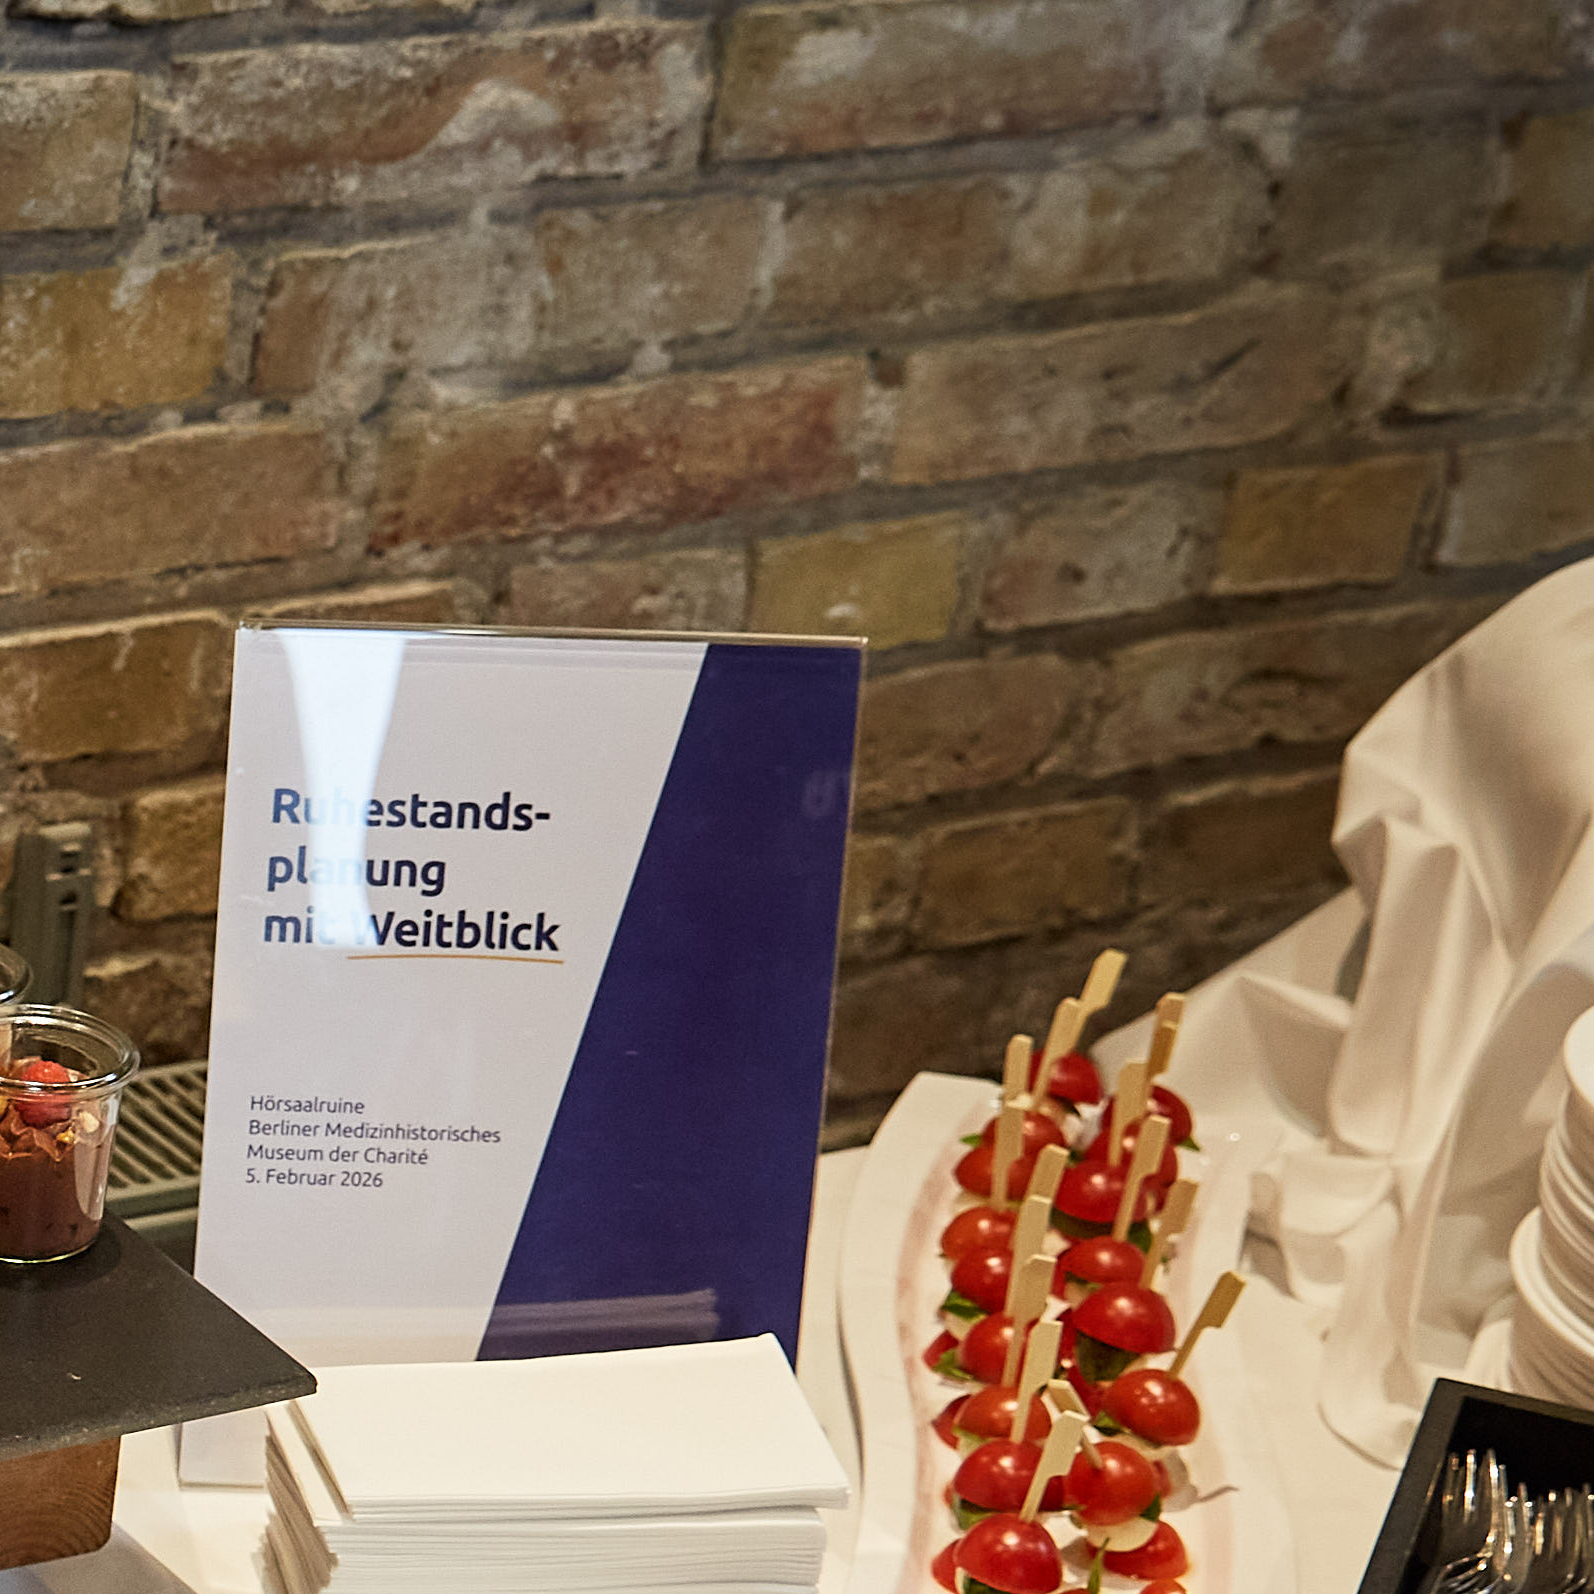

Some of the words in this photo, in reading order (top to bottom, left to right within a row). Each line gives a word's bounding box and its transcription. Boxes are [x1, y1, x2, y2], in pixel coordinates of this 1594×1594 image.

[249, 1095, 365, 1115] Hörsaalruine
[248, 1119, 321, 1138] Berliner
[324, 1122, 502, 1144] Medizinhistorisches
[246, 1144, 324, 1162] Museum
[329, 1145, 359, 1163] der
[363, 1147, 429, 1165] Charité
[245, 1168, 261, 1185] 5.
[265, 1168, 336, 1186] Februar
[340, 1171, 384, 1188] 2026
